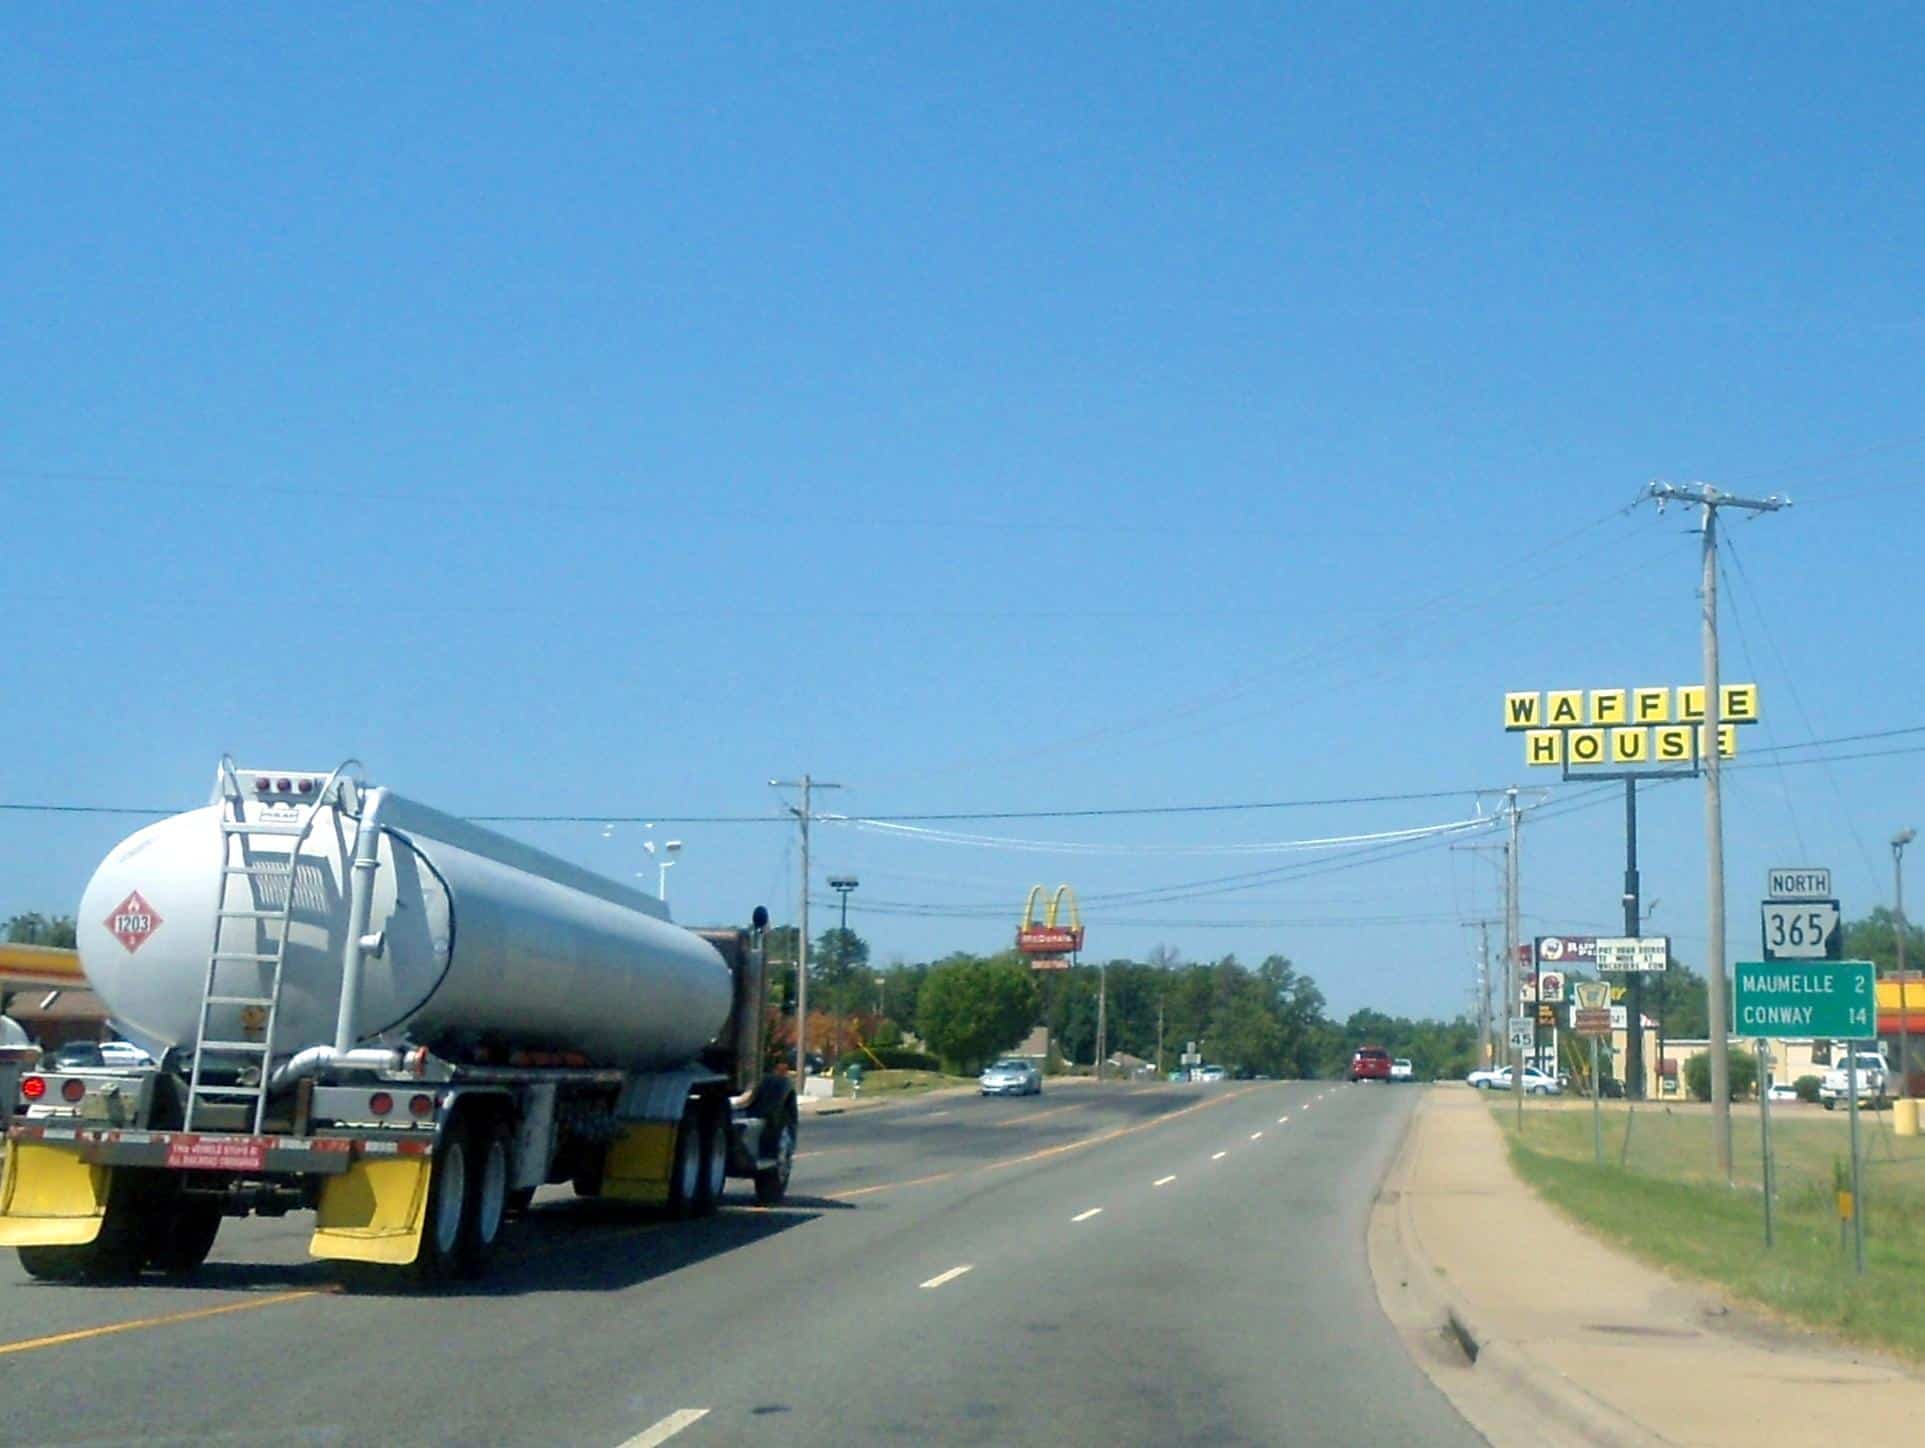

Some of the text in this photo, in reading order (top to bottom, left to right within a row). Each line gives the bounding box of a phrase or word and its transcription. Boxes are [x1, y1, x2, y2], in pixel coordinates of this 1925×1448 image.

[1511, 691, 1749, 722] WAFFLE
[1773, 874, 1826, 892] NORTH
[116, 914, 149, 932] 1203
[1771, 913, 1823, 946] 365
[1743, 975, 1865, 993] MAUMELLE 2
[1743, 1006, 1867, 1024] CONWAY 14
[1511, 1033, 1531, 1046] 45
